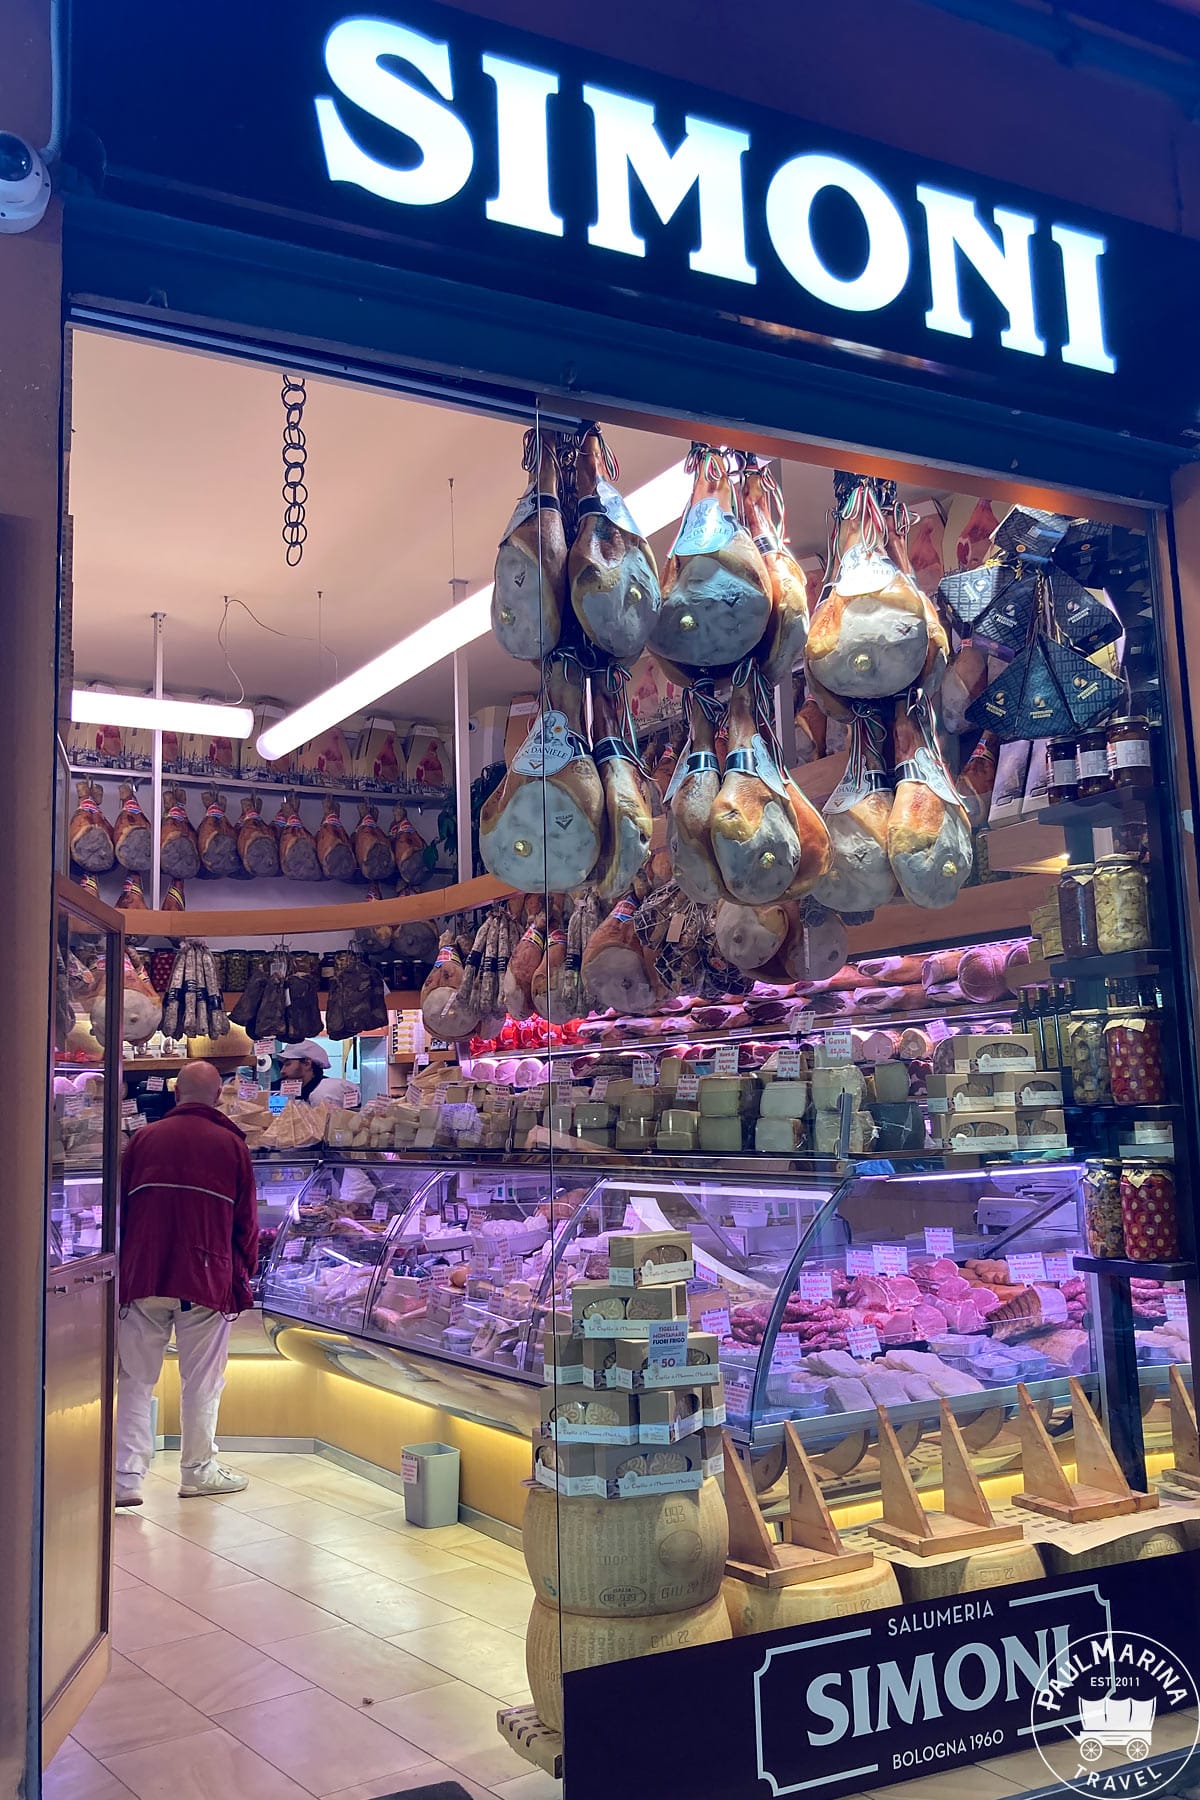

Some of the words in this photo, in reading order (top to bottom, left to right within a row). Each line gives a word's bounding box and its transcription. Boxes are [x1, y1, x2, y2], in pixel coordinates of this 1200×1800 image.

[314, 16, 1117, 375] SIMONI
[887, 1600, 995, 1637] SALUMERIA
[805, 1623, 1075, 1747] SIMONI
[892, 1737, 968, 1770] BOLOGNA
[969, 1729, 1005, 1751] 1960
